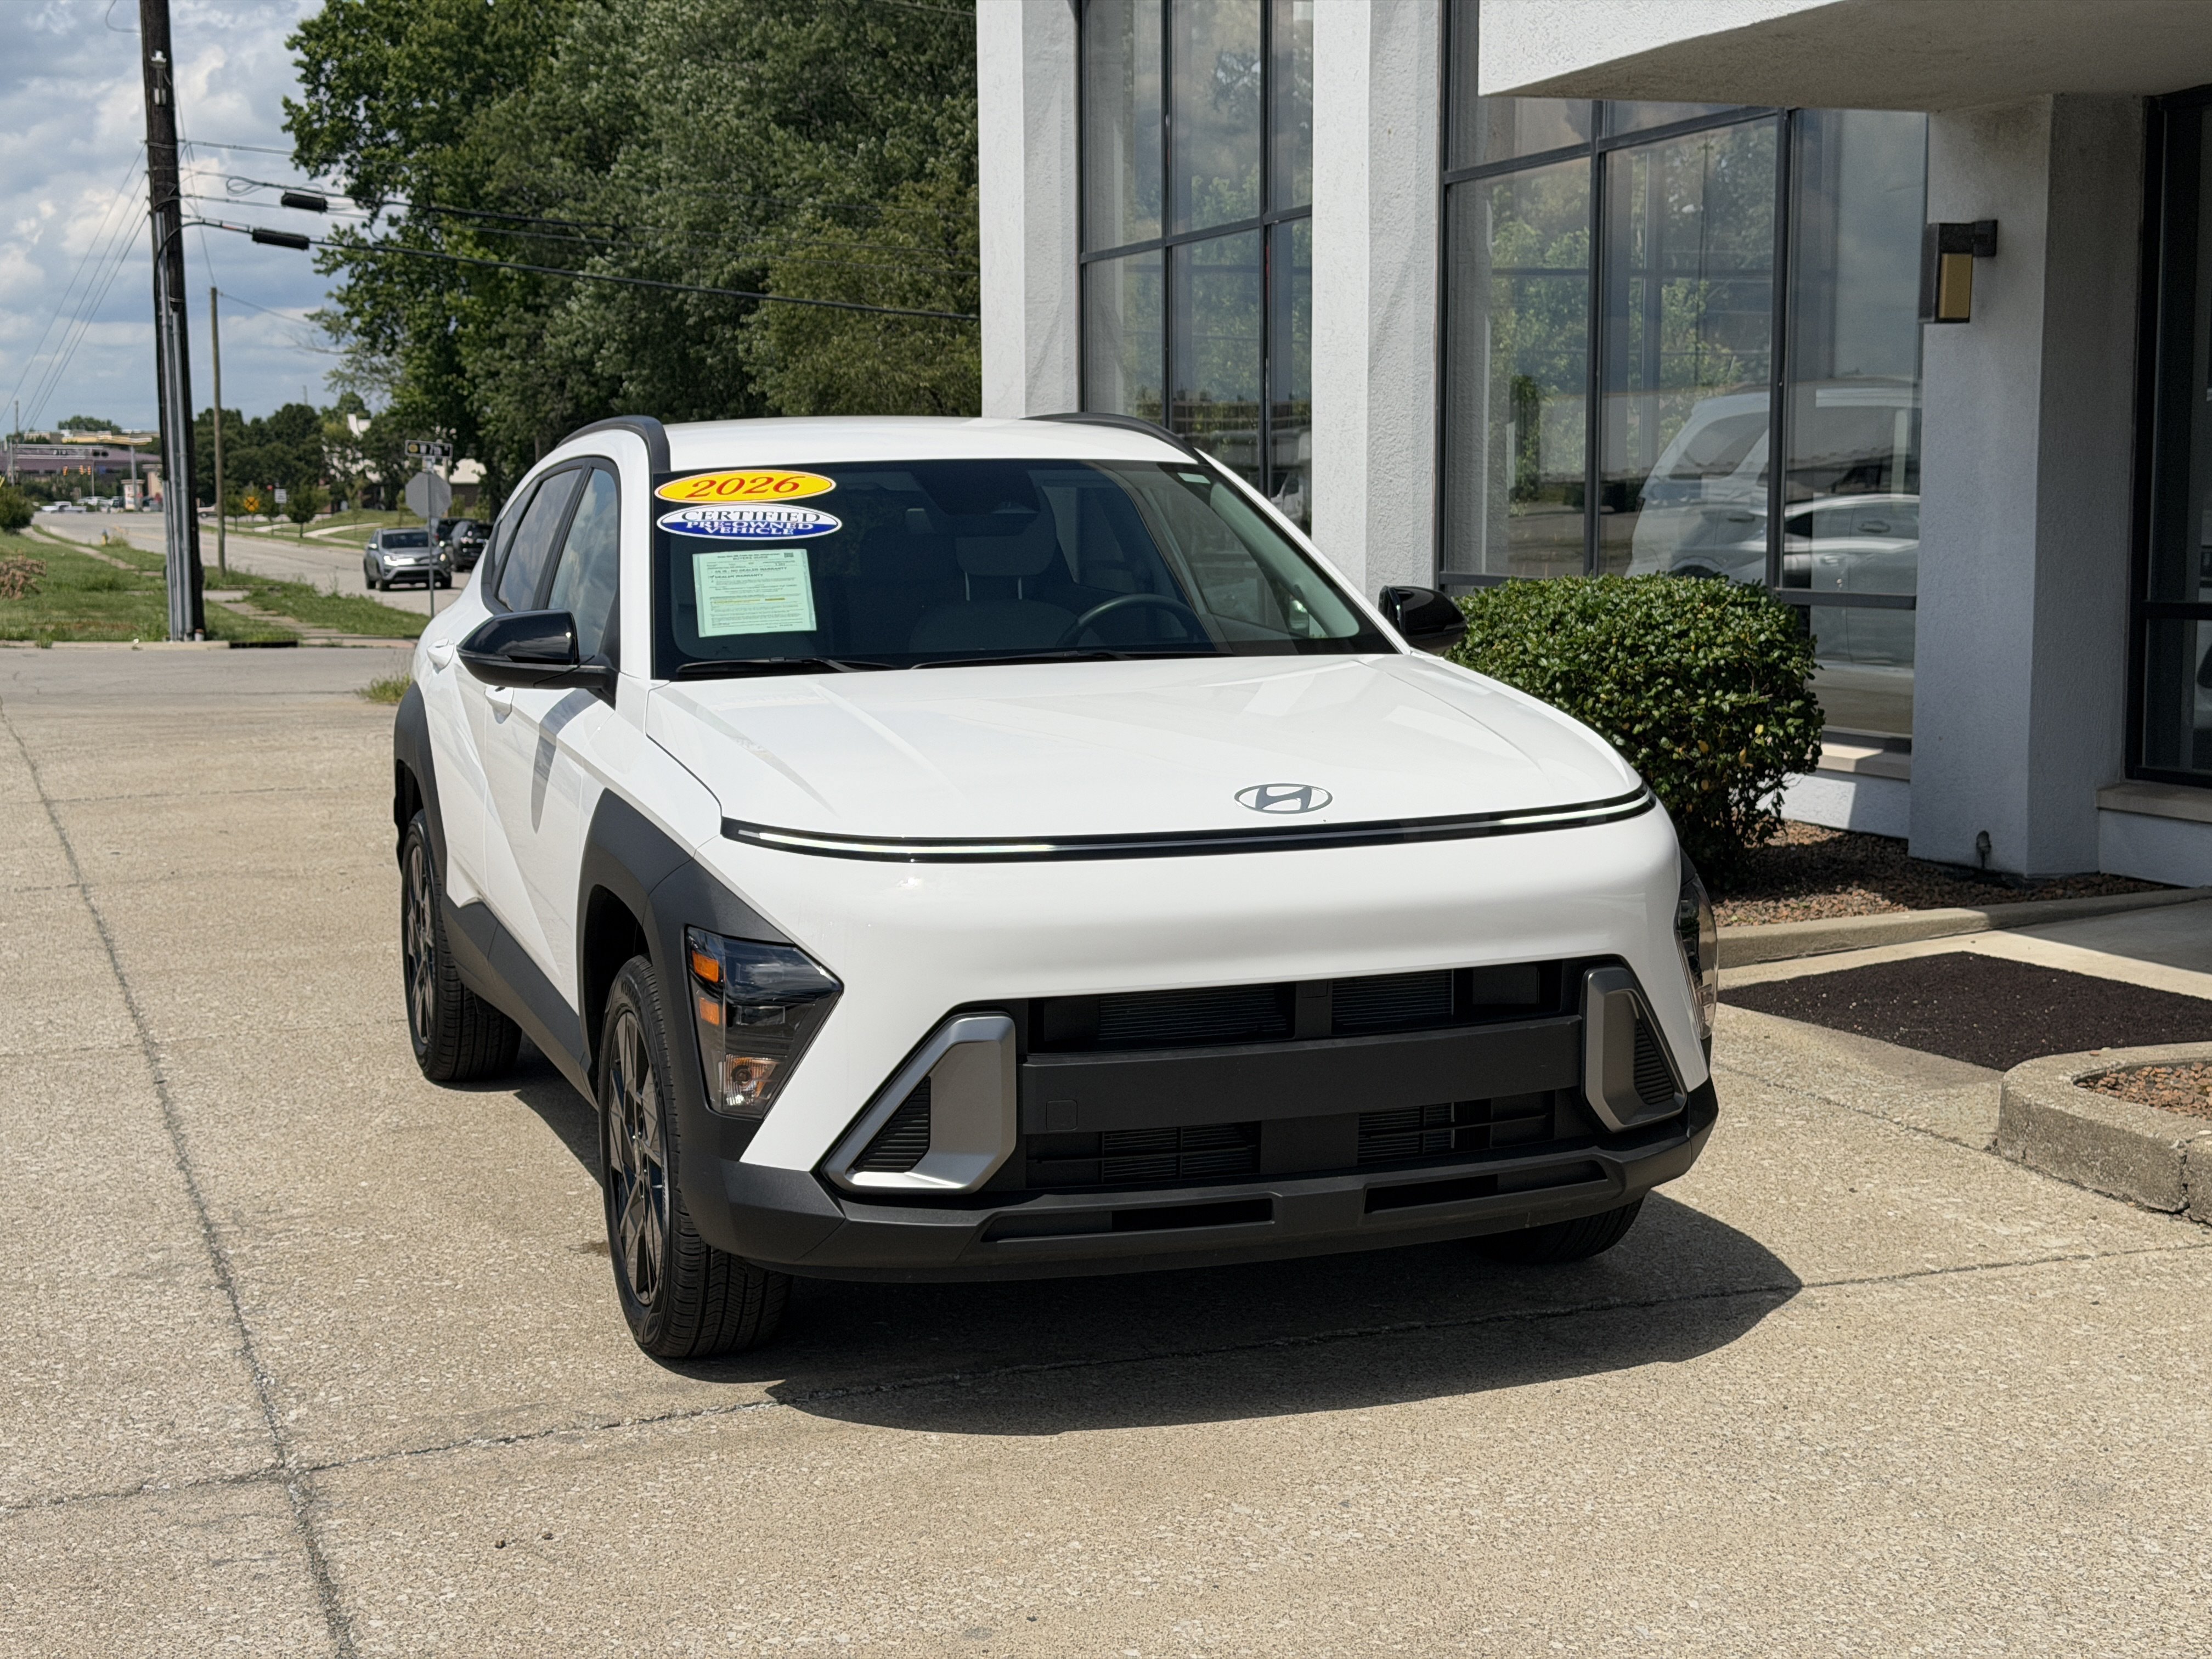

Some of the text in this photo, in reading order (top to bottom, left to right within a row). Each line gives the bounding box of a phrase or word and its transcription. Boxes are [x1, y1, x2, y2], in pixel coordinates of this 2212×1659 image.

[685, 476, 806, 498] 2026
[681, 511, 820, 522] CERTIFIED
[686, 521, 814, 530] PRE-OWNED
[703, 527, 794, 535] VEHICLE
